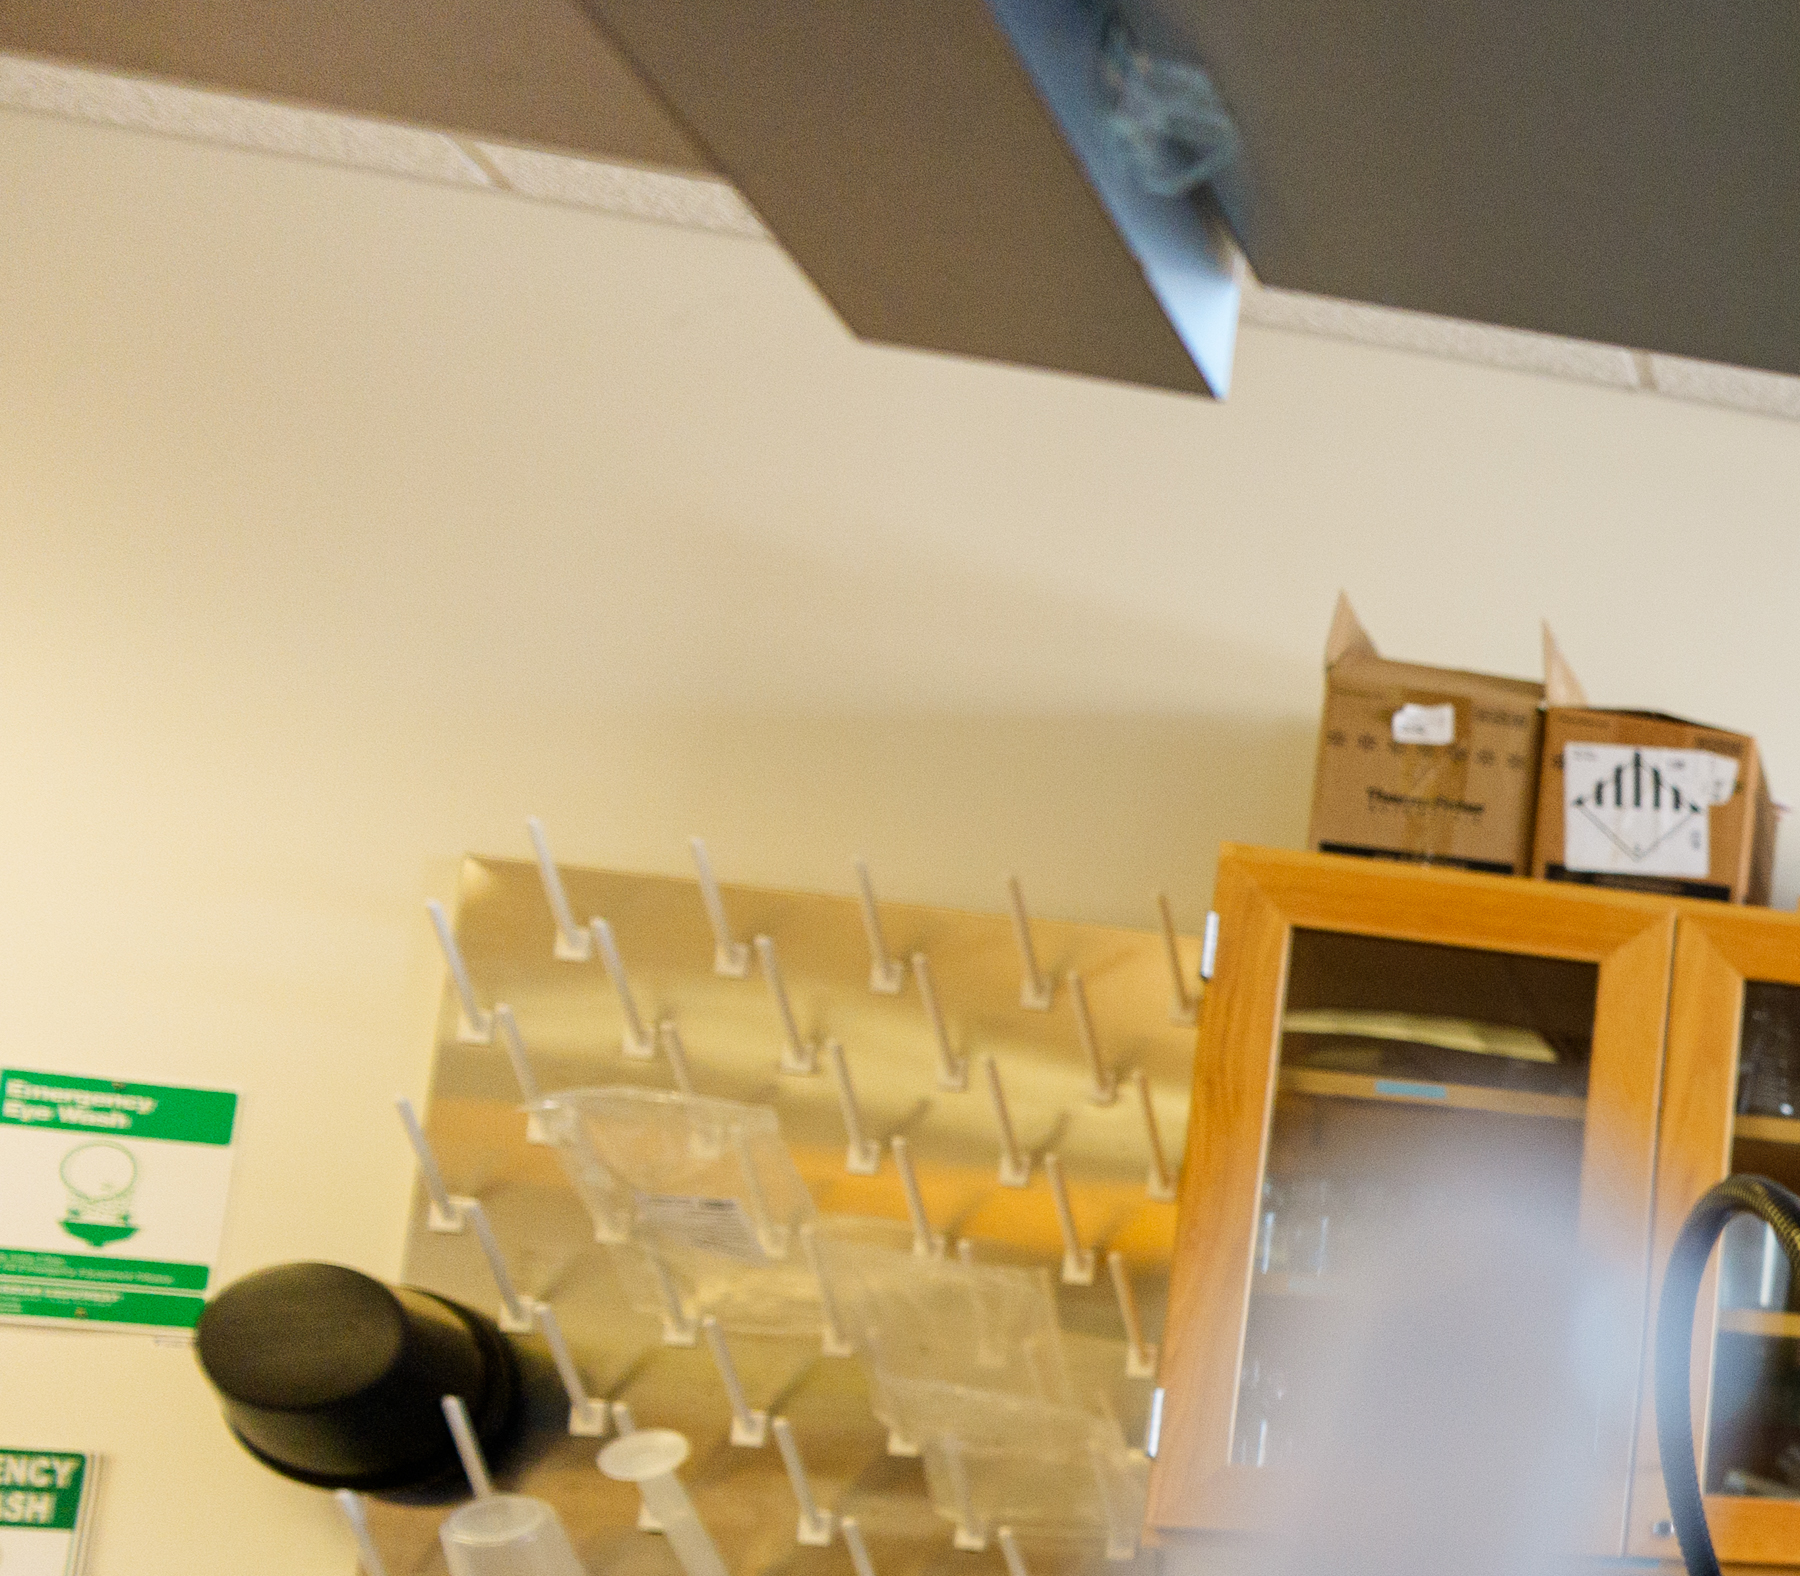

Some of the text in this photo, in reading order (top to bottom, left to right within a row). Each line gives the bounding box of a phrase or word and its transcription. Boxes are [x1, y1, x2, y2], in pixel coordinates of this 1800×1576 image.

[6, 1078, 158, 1115] Emergency
[3, 1099, 133, 1129] Eye Wash
[0, 1490, 56, 1523] SH
